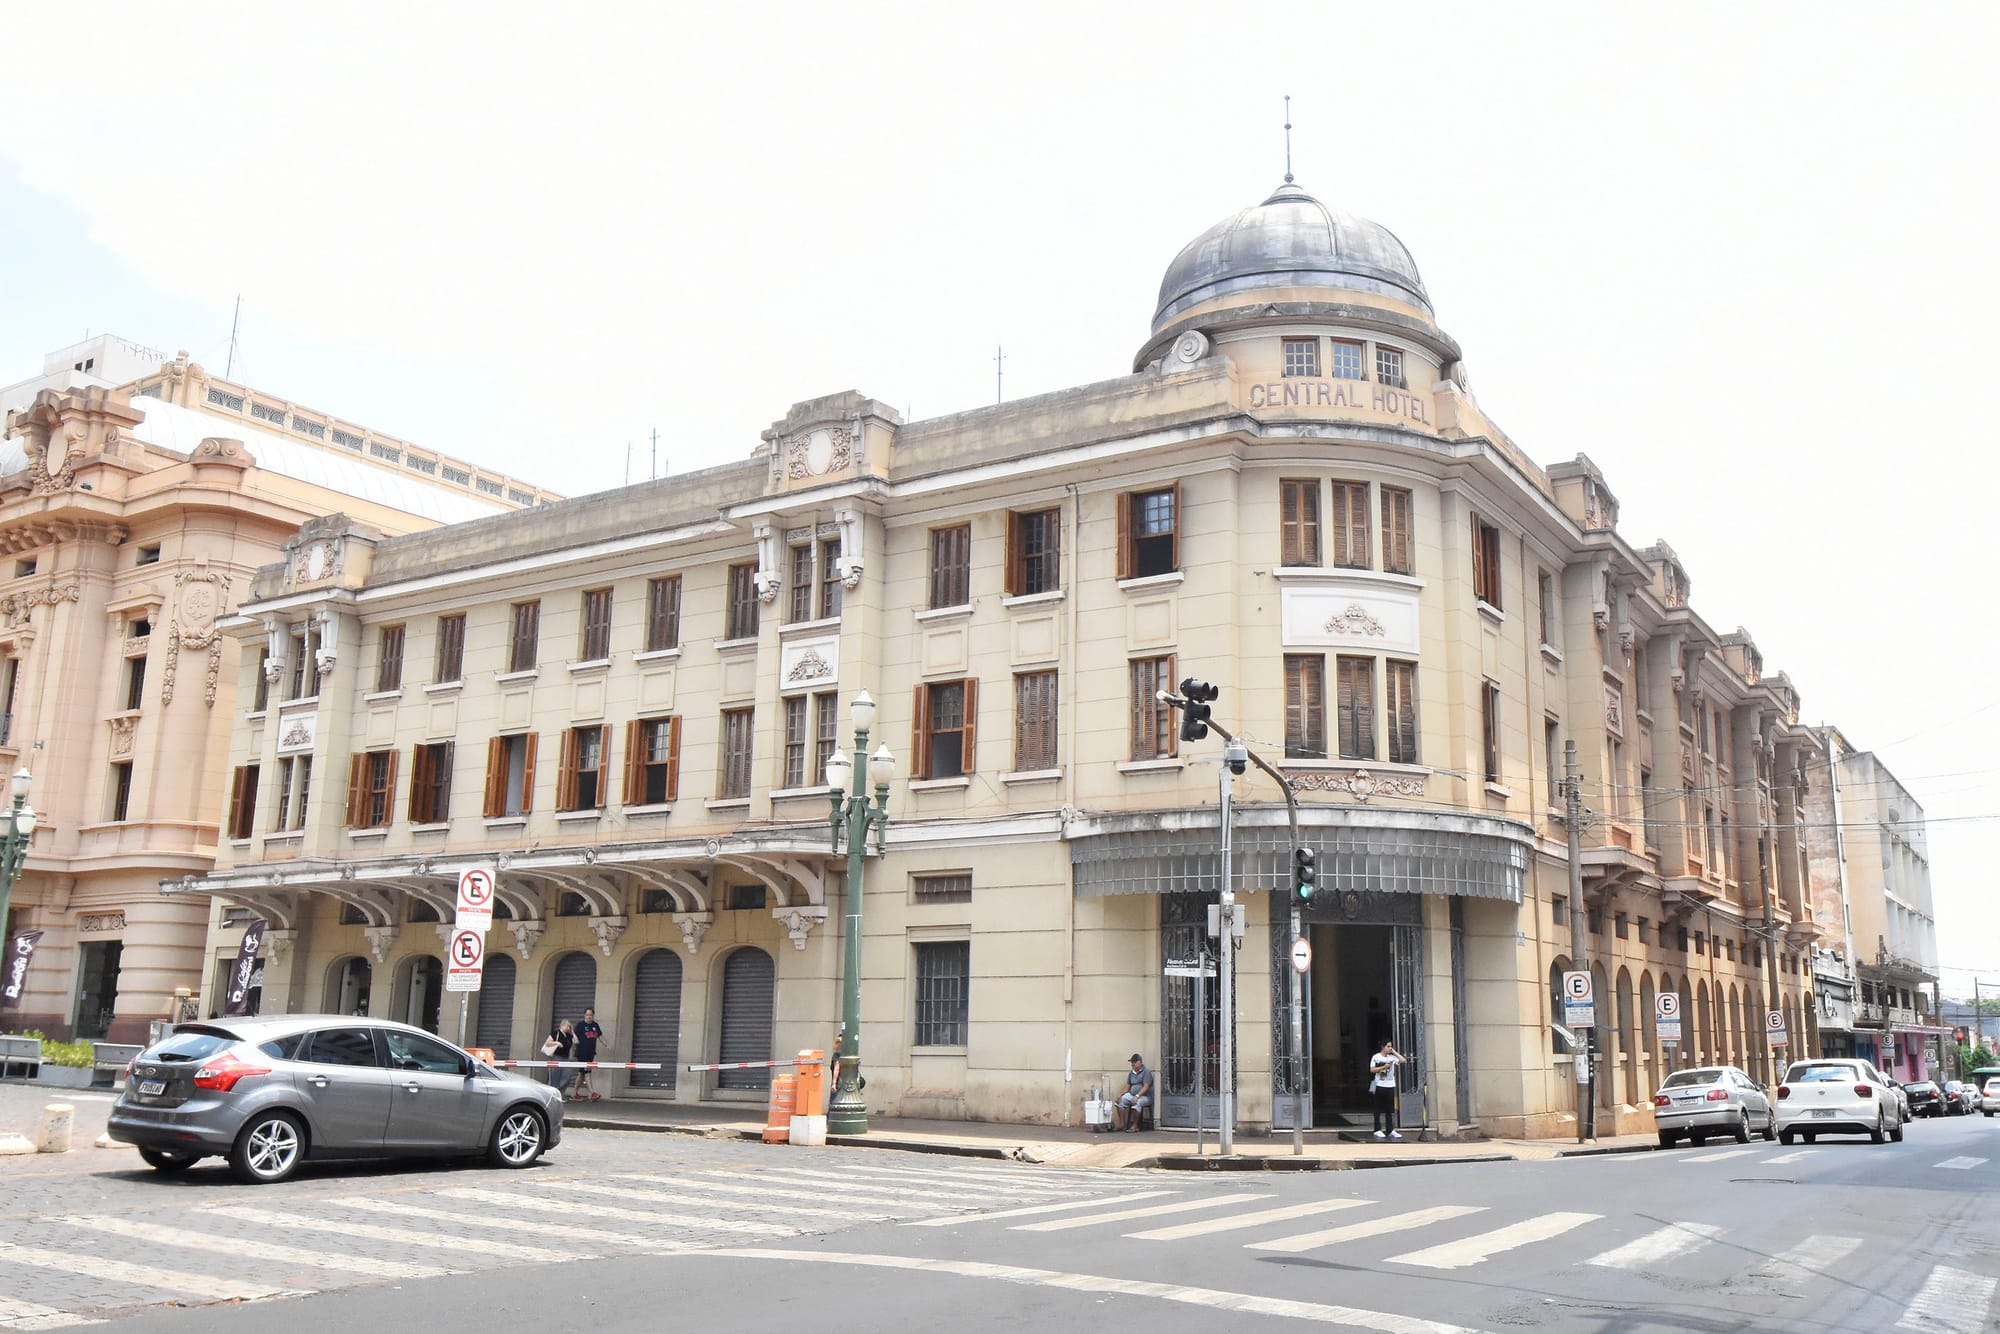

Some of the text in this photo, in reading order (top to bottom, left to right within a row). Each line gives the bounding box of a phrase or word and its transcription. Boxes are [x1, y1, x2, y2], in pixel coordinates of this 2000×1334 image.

[1250, 382, 1431, 426] CENTRAL HOTEL
[470, 877, 483, 898] E
[461, 938, 473, 959] E
[1573, 979, 1583, 994] E
[1663, 998, 1672, 1011] E
[1771, 1015, 1779, 1025] E
